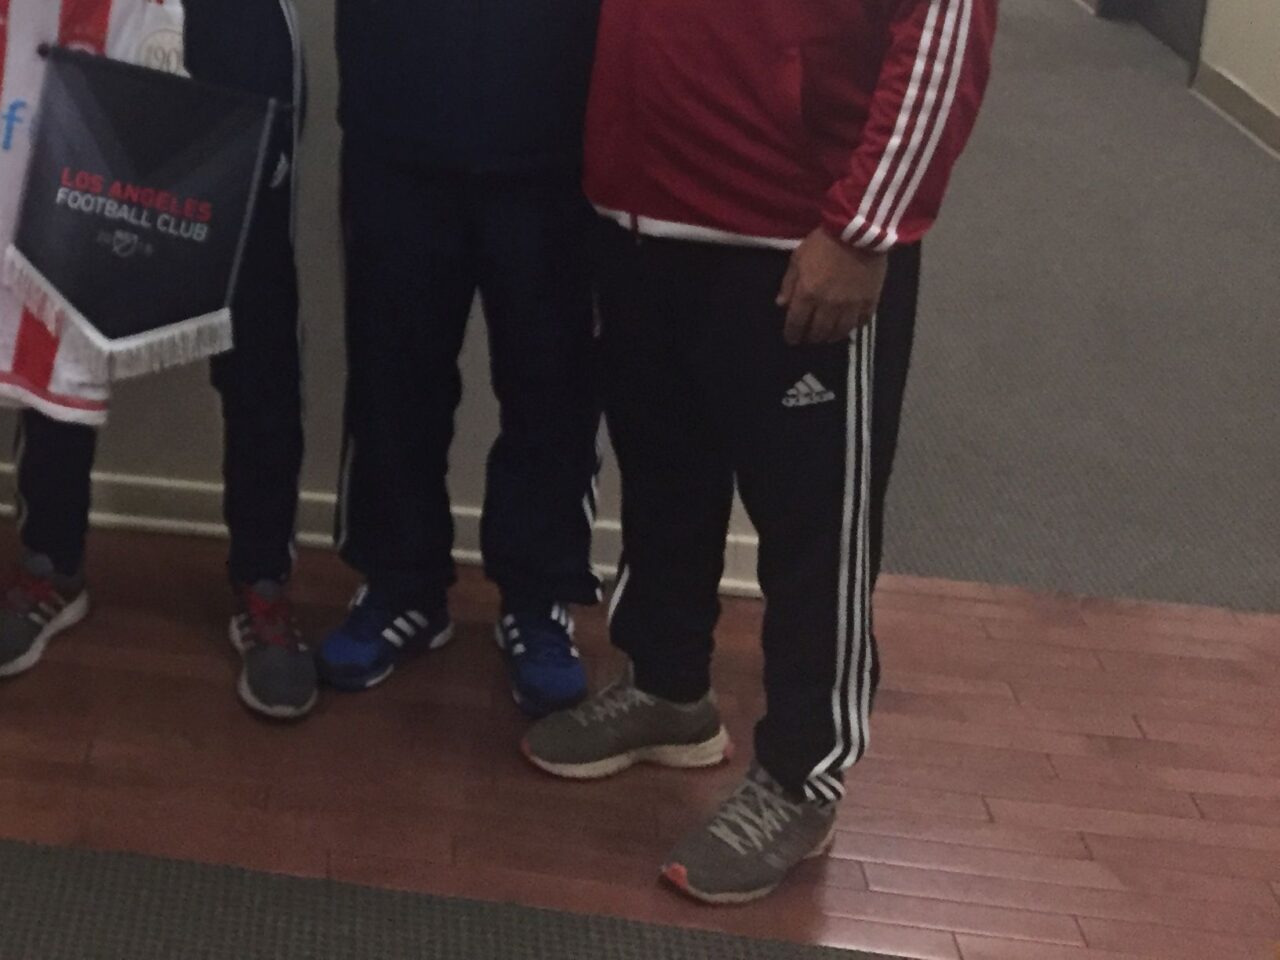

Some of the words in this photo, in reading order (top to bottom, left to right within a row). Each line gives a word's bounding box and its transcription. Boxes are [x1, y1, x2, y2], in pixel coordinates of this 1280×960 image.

[55, 186, 152, 228] FOOTBALL
[156, 212, 209, 241] CLUB
[60, 167, 104, 194] LOS
[108, 180, 213, 222] ANGELES
